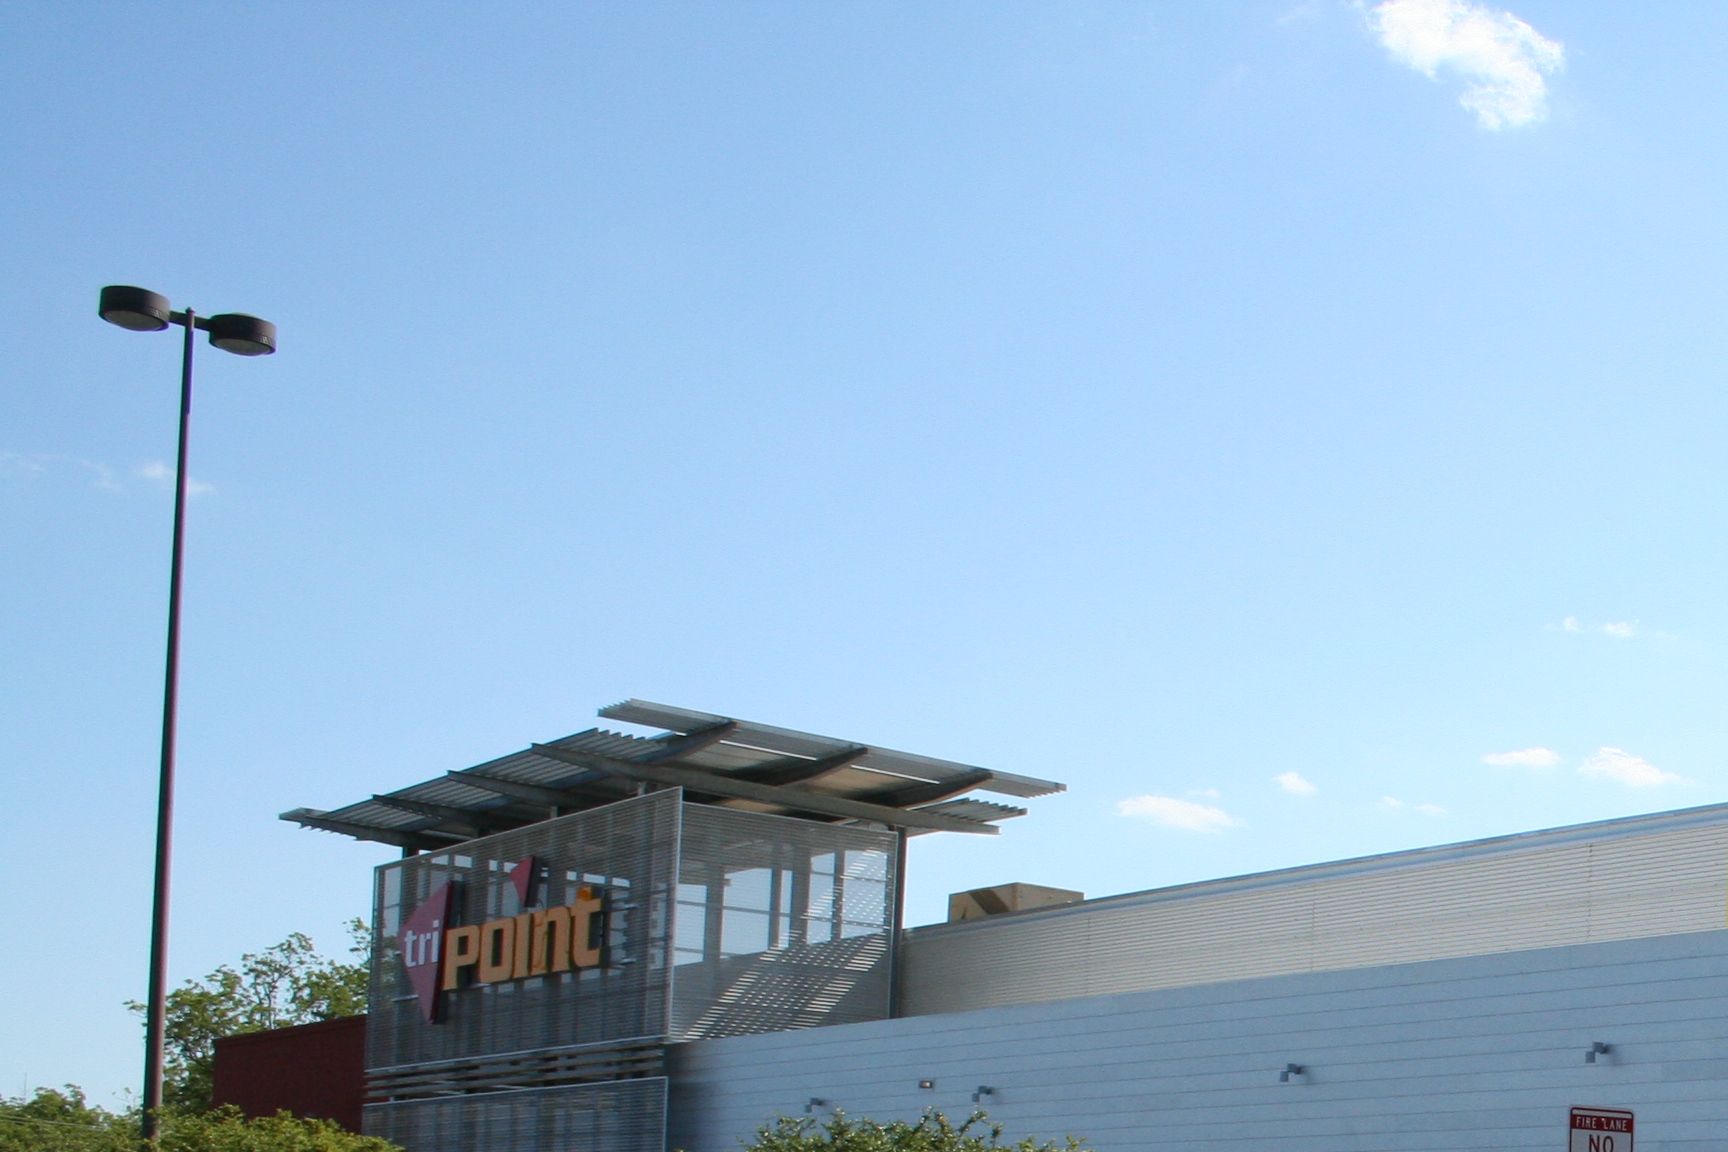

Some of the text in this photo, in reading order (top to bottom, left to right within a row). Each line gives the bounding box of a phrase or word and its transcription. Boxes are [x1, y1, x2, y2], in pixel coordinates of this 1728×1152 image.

[403, 919, 440, 968] tri
[1575, 1116, 1628, 1132] FIRE LANE
